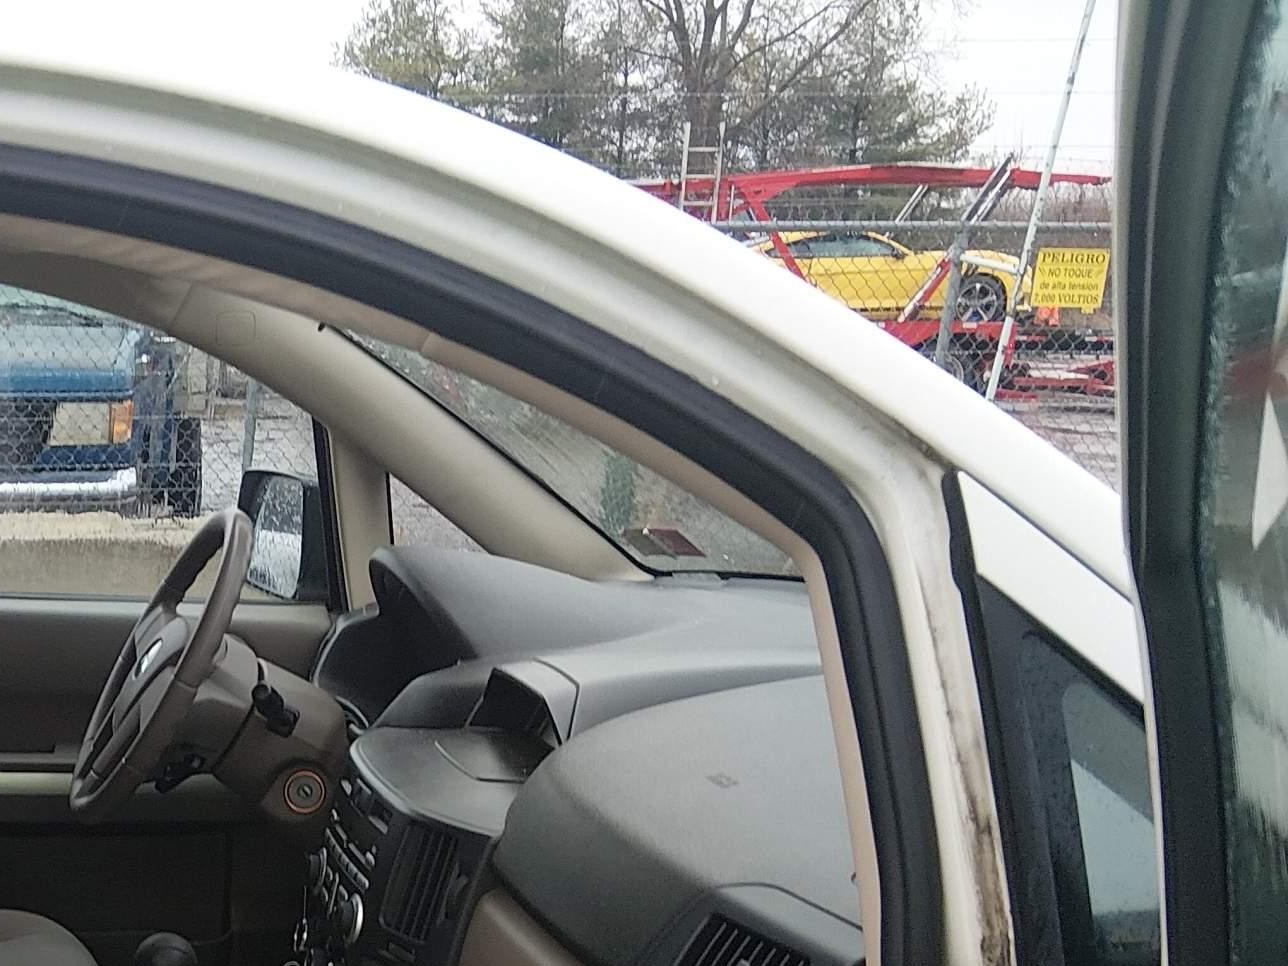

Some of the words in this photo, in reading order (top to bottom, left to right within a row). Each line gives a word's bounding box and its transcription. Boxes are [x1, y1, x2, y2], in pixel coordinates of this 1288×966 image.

[1042, 252, 1106, 263] PELIGRO
[1048, 268, 1061, 278] NO
[1063, 268, 1093, 278] TOQUE
[1039, 280, 1050, 290] de
[1051, 281, 1066, 290] alta
[1034, 293, 1056, 304] 7,000
[1058, 293, 1099, 304] VOLTIOS
